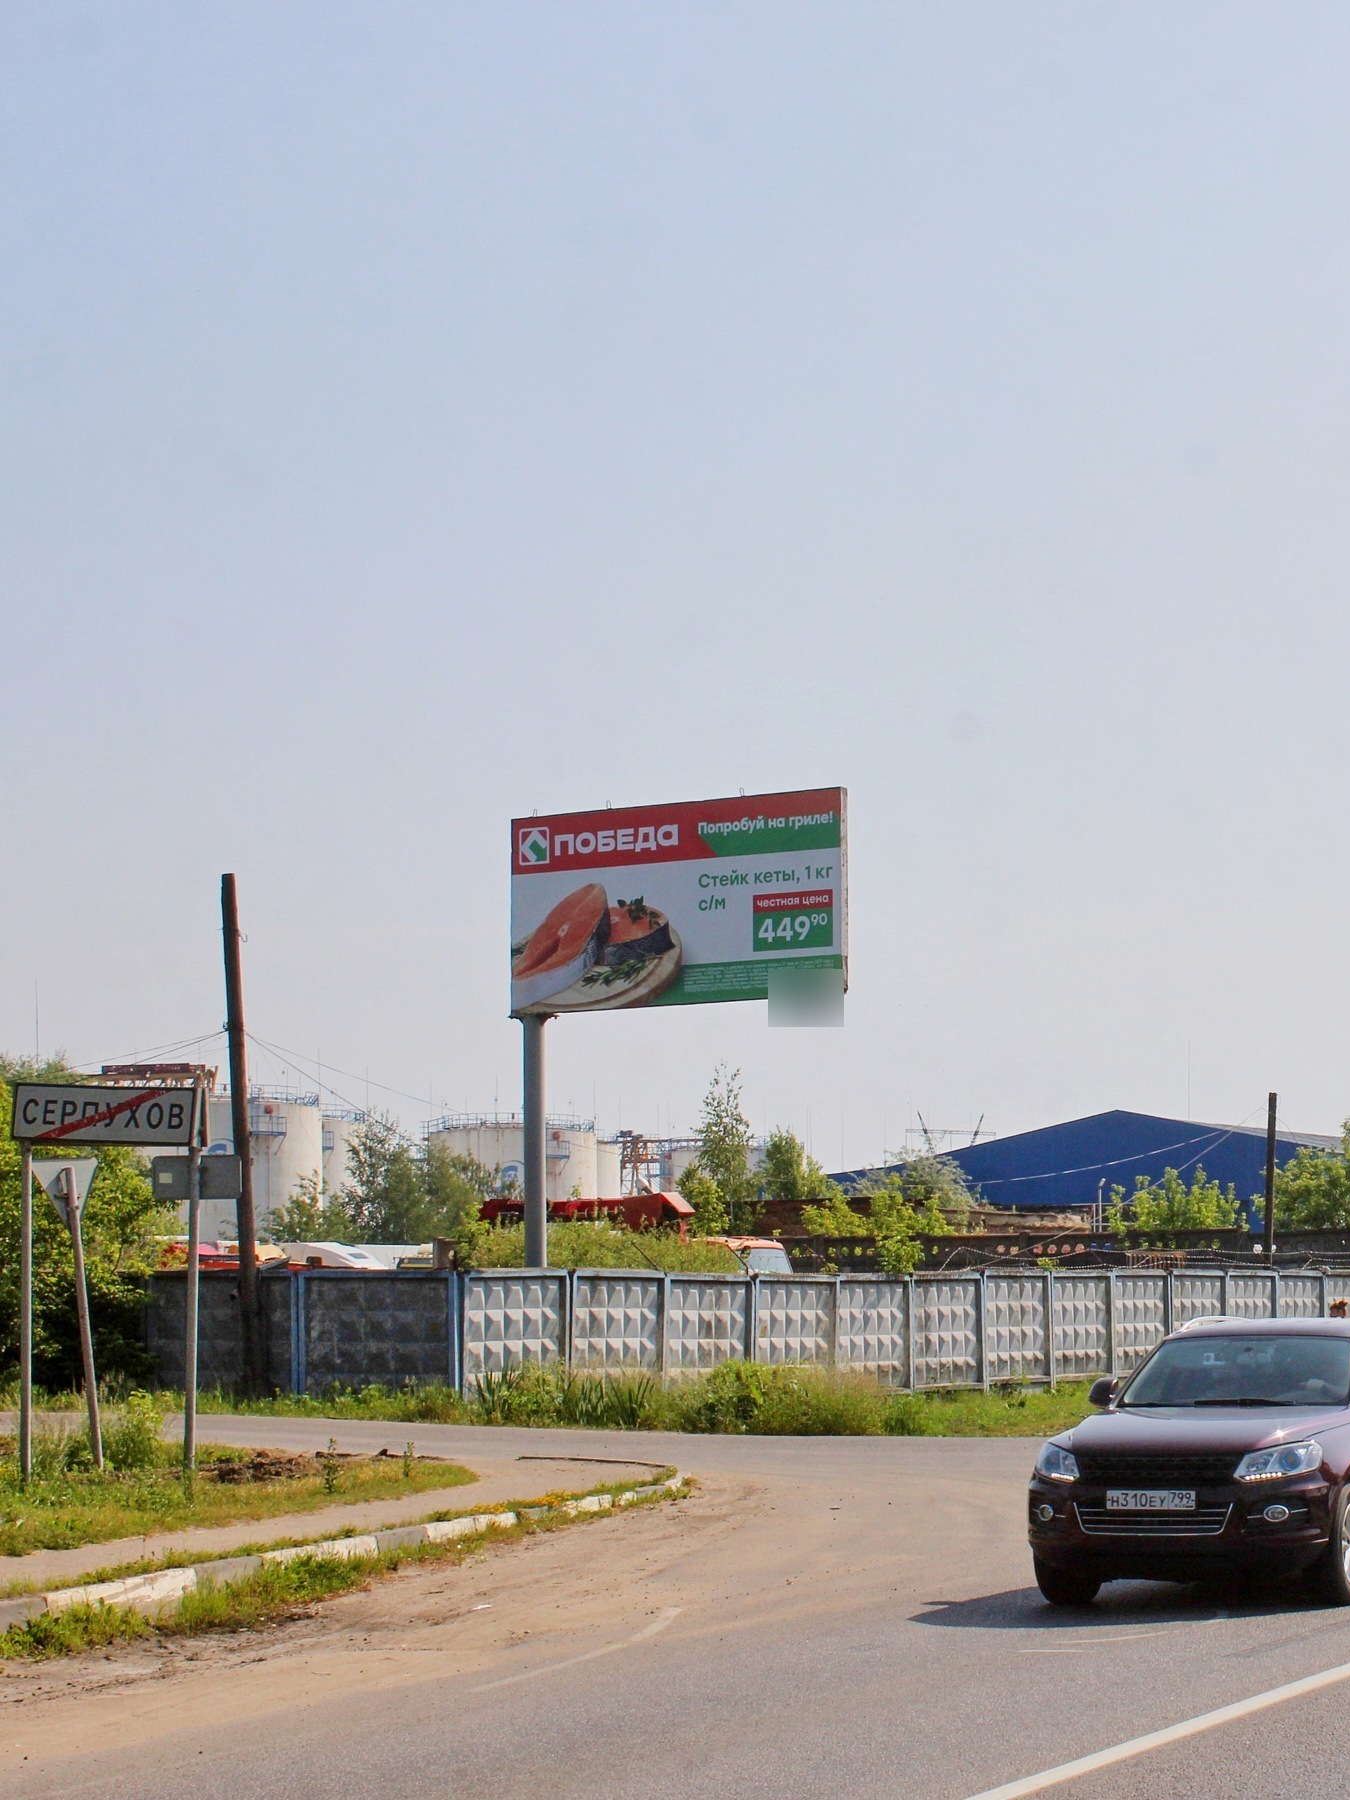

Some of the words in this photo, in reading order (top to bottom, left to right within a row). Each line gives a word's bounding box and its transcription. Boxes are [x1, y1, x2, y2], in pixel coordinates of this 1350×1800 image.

[697, 815, 765, 836] Попробуй
[768, 817, 785, 829] на
[789, 811, 834, 830] гриле!
[698, 869, 749, 888] Стейк
[754, 869, 800, 884] кеты,
[804, 865, 811, 880] 1
[815, 866, 833, 880] кг
[698, 895, 726, 911] с/м
[757, 897, 800, 908] честная
[802, 894, 829, 906] цена
[22, 1098, 185, 1130] СЕРПУХОВ
